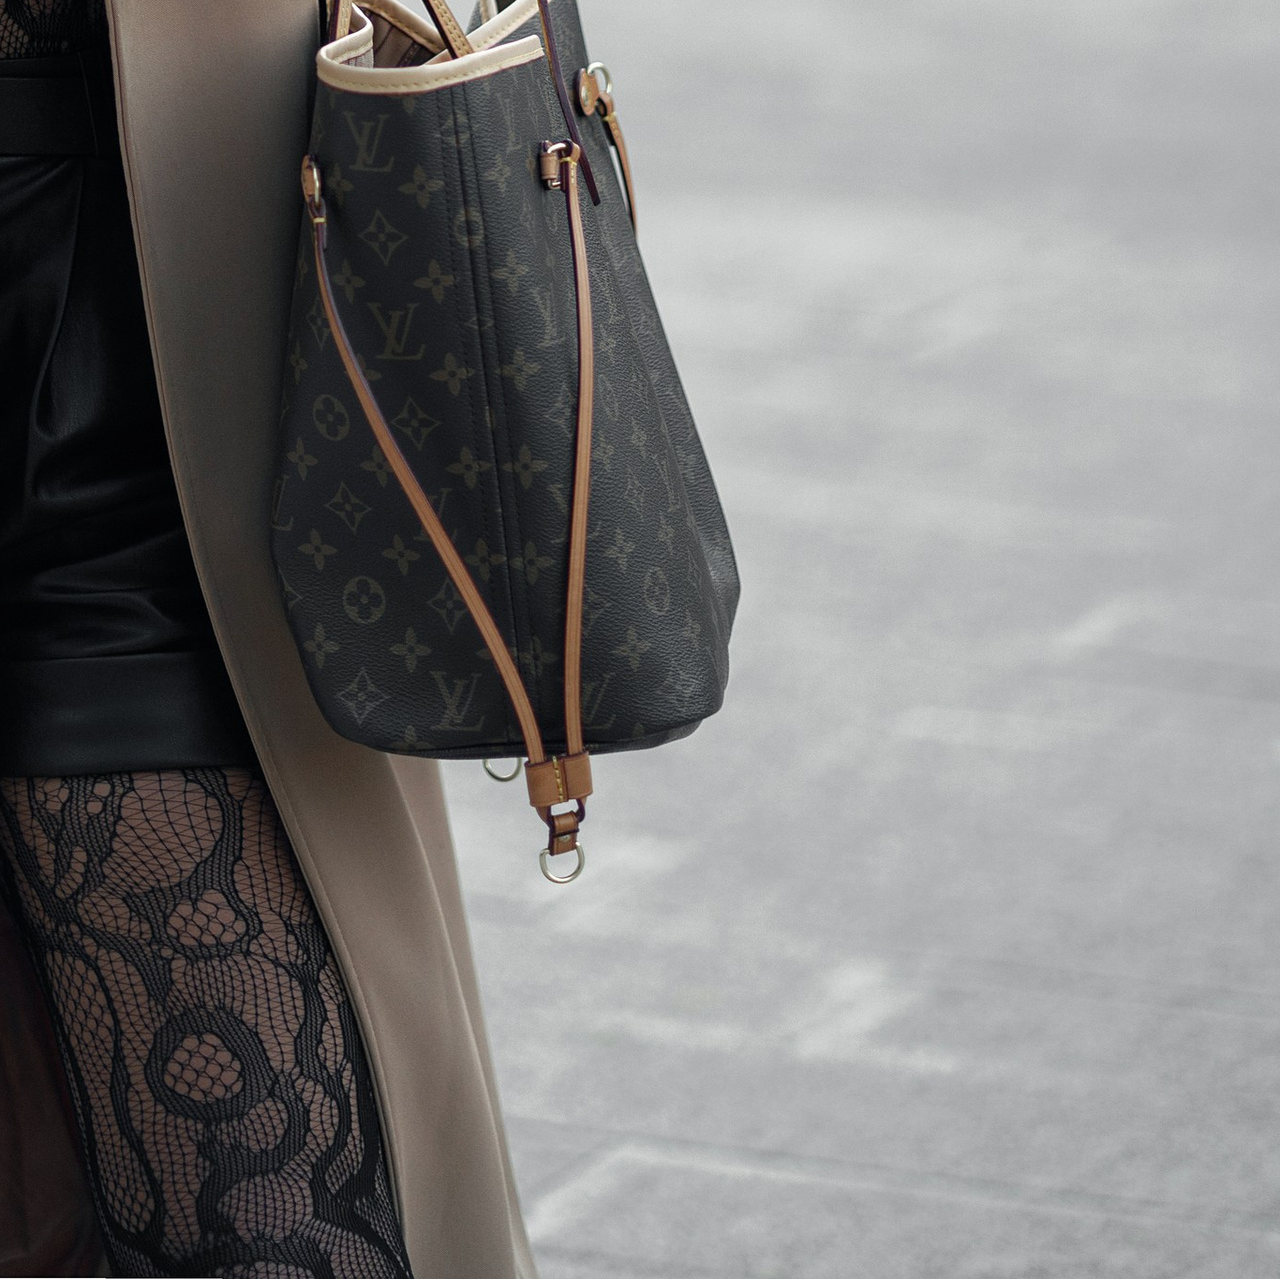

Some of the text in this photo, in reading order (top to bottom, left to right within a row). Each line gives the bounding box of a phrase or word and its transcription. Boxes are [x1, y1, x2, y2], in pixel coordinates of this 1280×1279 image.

[343, 110, 394, 172] LV
[368, 302, 425, 360] LV
[429, 670, 486, 731] LV
